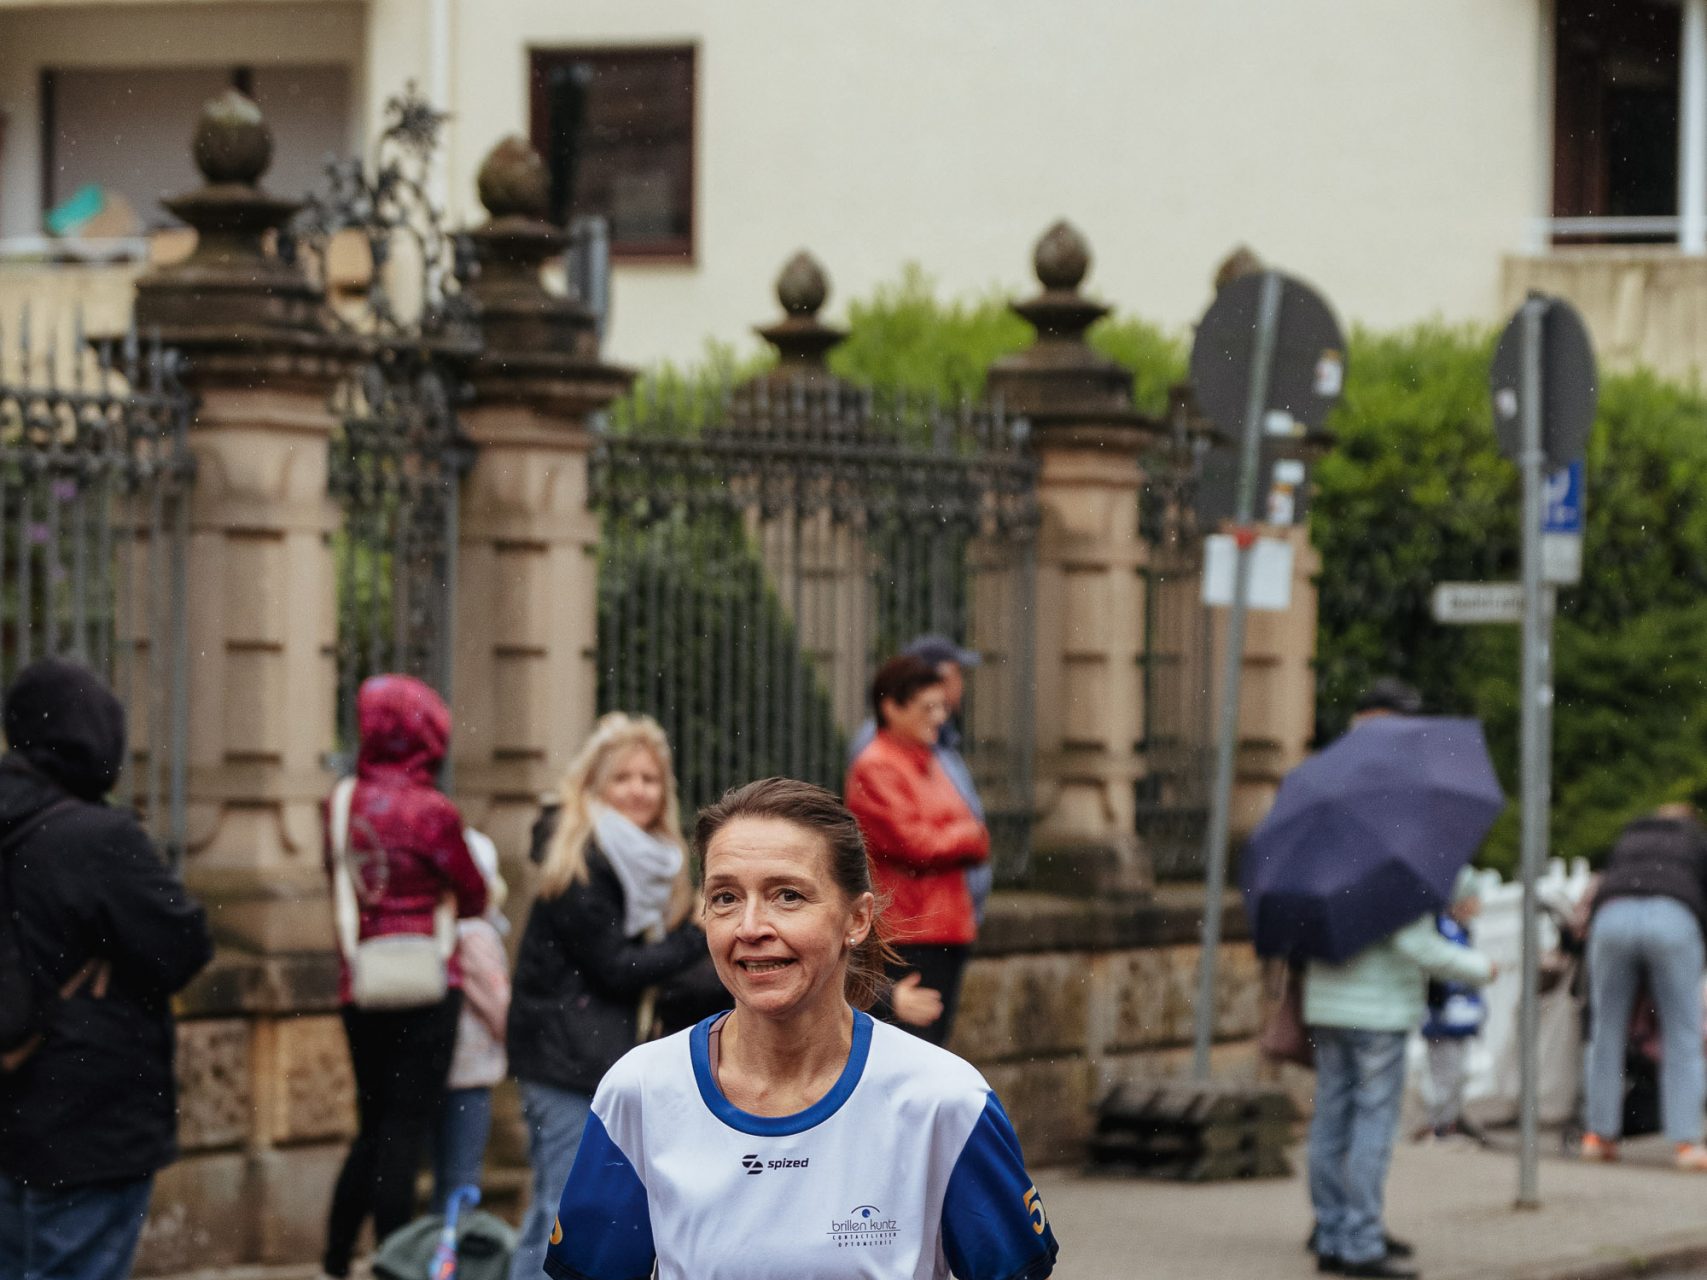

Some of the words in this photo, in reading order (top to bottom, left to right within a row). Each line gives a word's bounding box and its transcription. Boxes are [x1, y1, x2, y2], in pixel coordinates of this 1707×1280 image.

[767, 1157, 810, 1171] spized
[831, 1219, 867, 1232] brillen
[870, 1218, 897, 1231] kuntz
